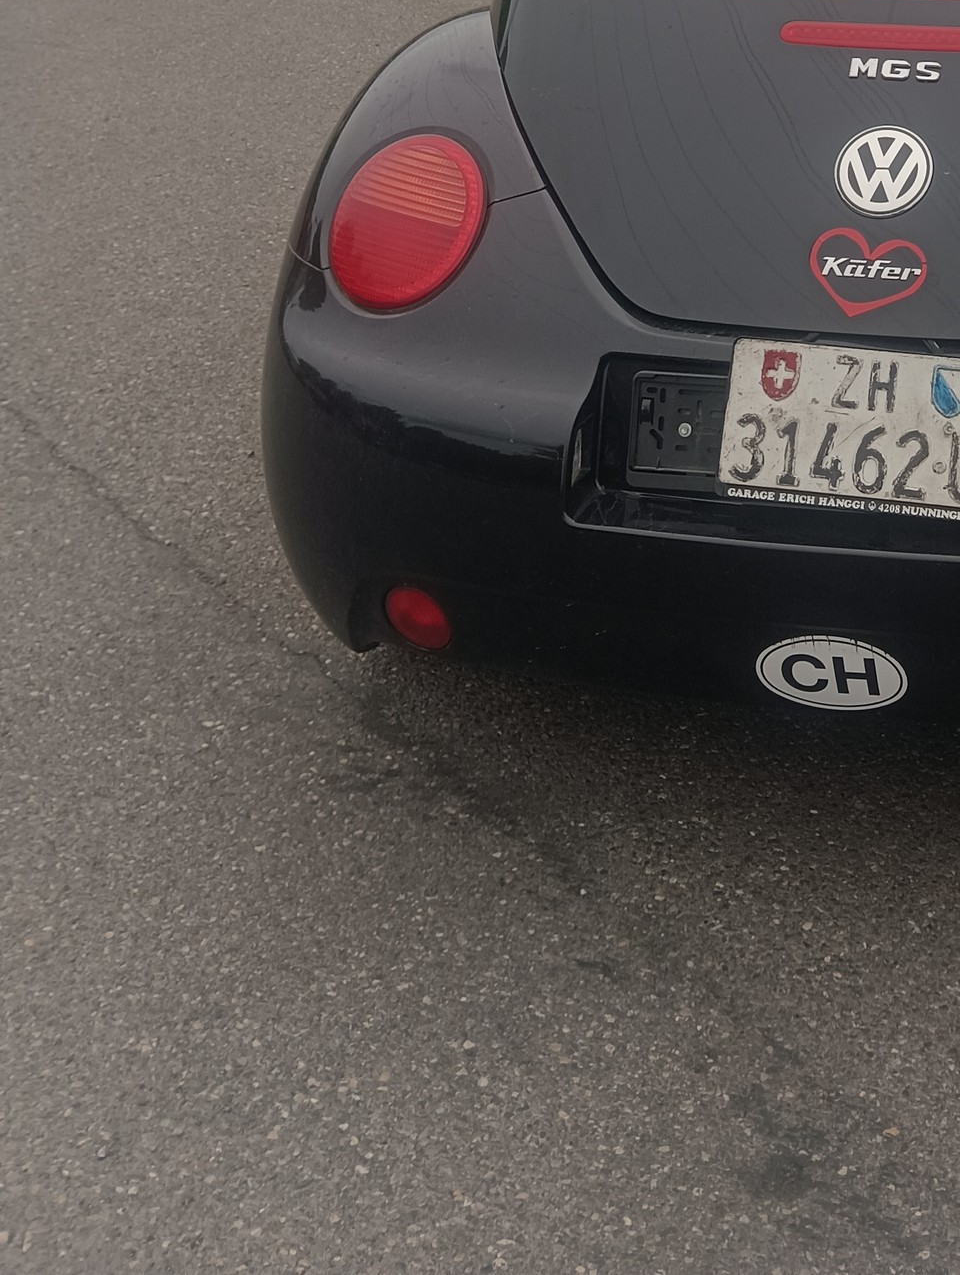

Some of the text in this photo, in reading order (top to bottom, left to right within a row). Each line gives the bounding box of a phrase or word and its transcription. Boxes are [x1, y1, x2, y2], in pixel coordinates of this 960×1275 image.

[849, 57, 942, 82] MGS
[831, 354, 900, 413] ZH
[727, 487, 775, 501] GARAGE
[778, 492, 815, 505] ERICH
[818, 496, 865, 511] HÄNGGI
[878, 503, 901, 514] 4208
[781, 653, 881, 696] CH
